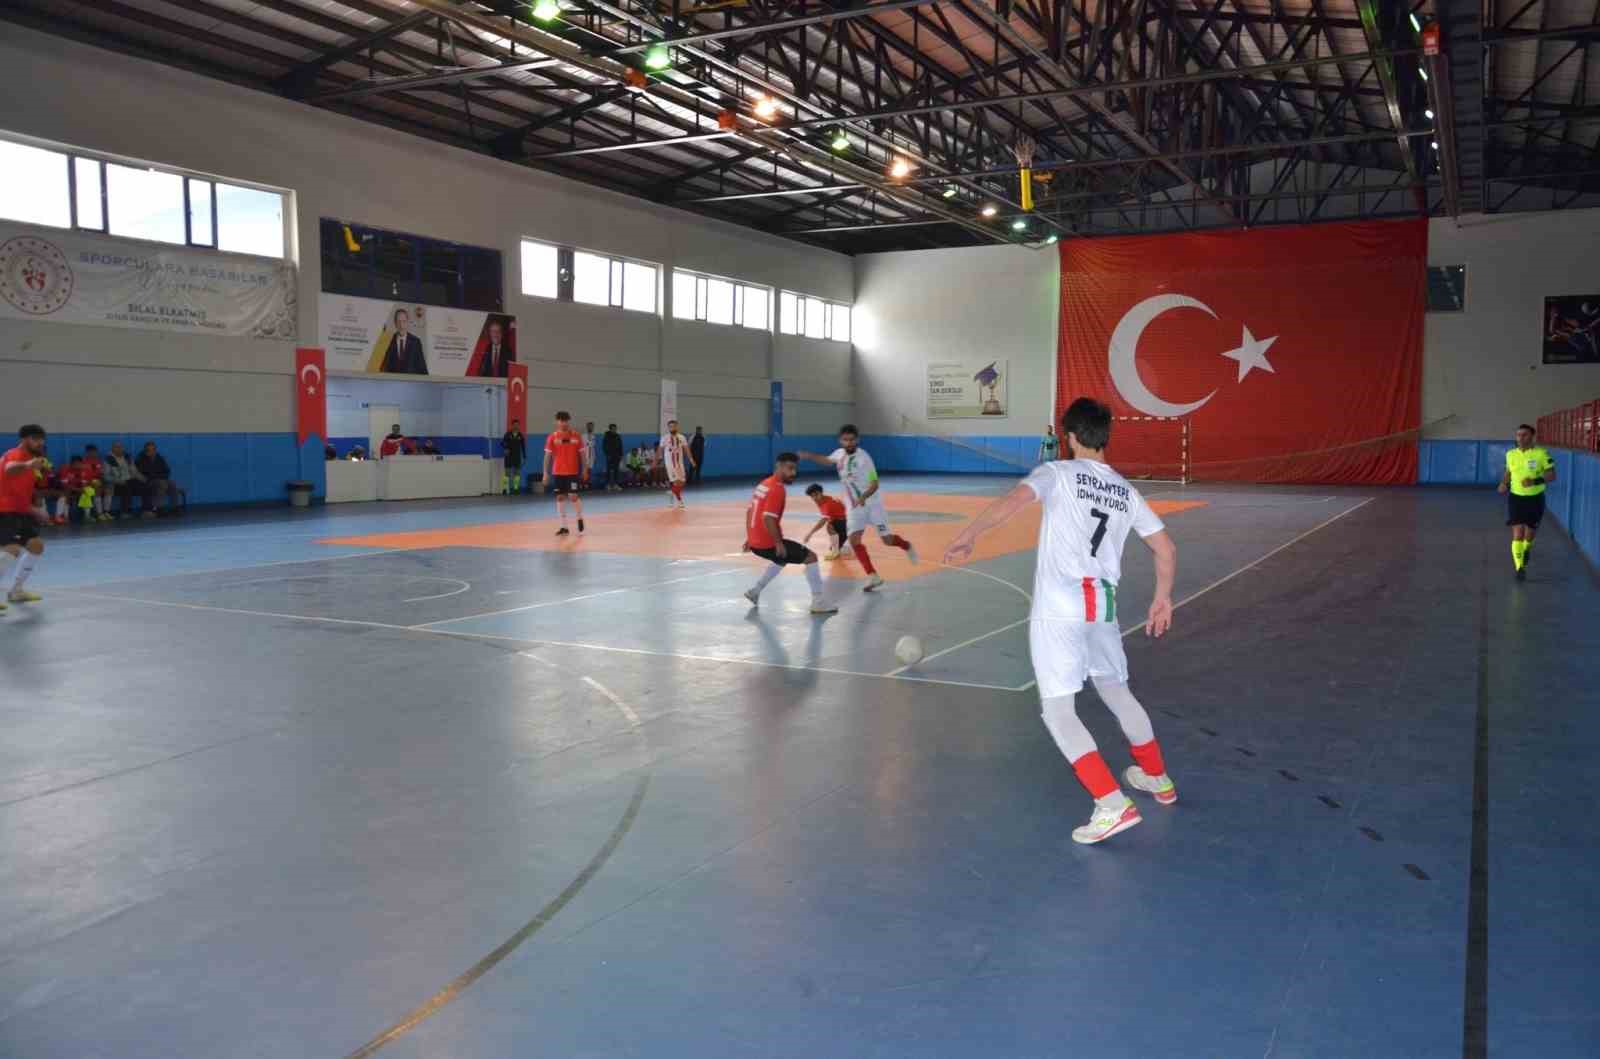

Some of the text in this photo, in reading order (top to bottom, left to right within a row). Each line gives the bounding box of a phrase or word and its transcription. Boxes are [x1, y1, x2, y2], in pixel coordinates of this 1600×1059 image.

[1076, 473, 1130, 501] SEYRANTEPE
[1104, 496, 1129, 512] YURDU
[1090, 508, 1109, 557] 7
